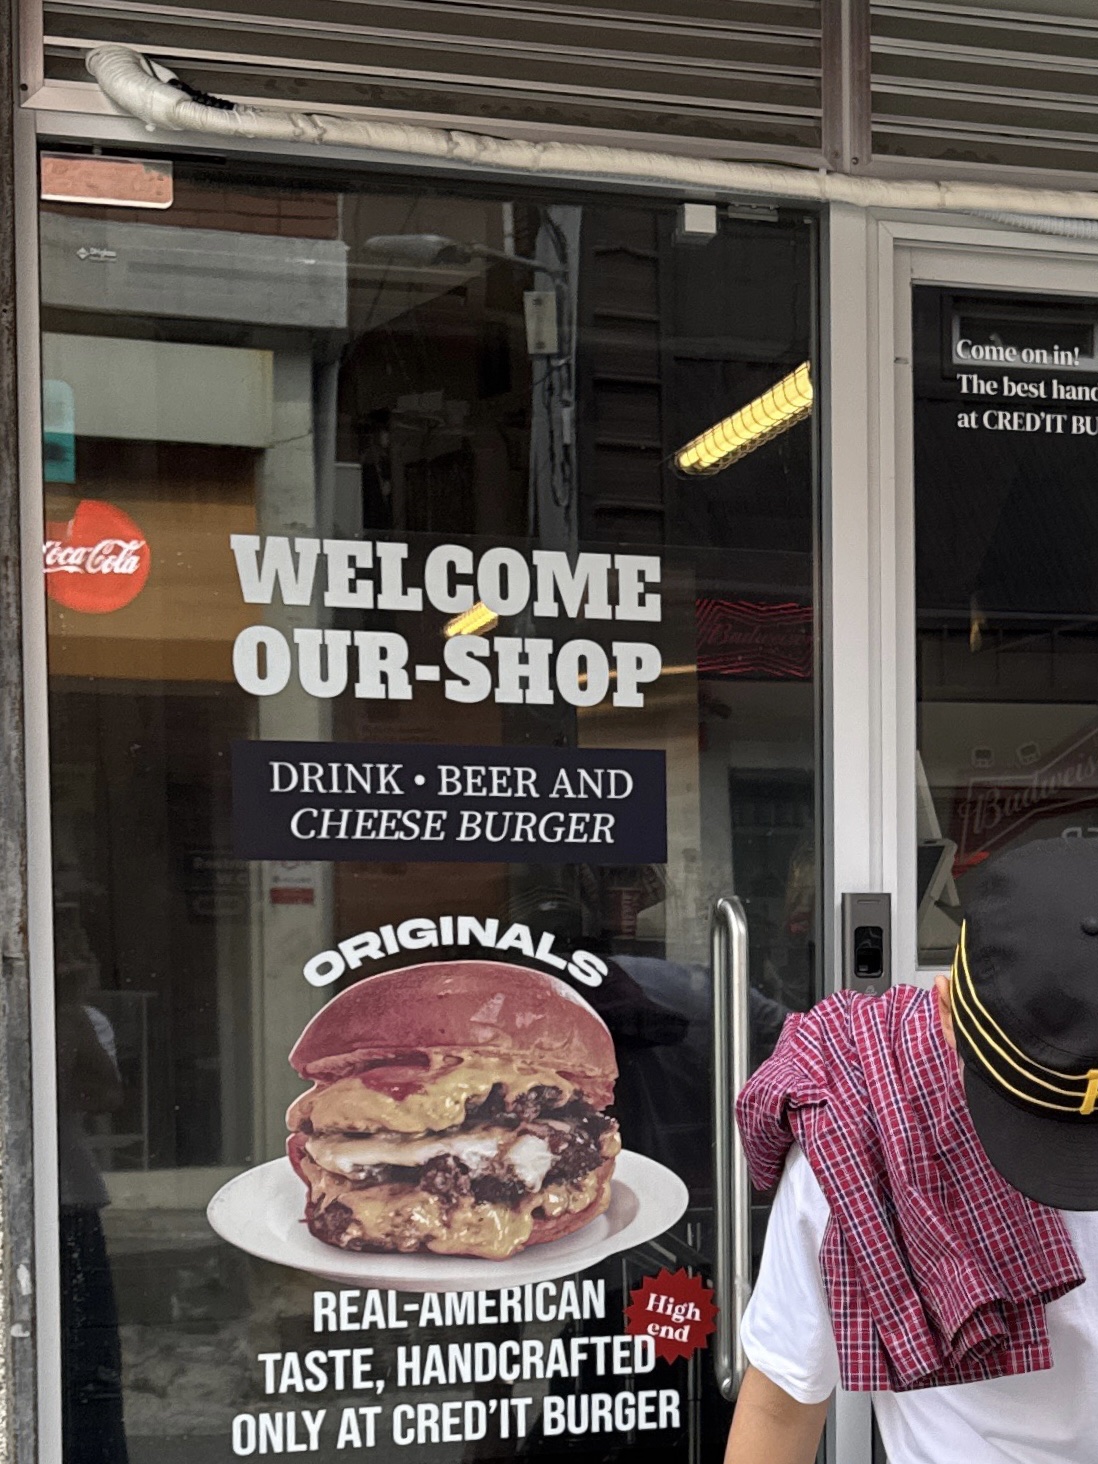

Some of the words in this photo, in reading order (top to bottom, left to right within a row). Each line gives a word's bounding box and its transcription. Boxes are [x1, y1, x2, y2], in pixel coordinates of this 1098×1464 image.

[957, 340, 1016, 364] Come
[1021, 349, 1048, 364] on
[1052, 345, 1080, 366] in!
[957, 374, 997, 395] The
[1003, 377, 1046, 398] best
[958, 412, 977, 428] at
[983, 411, 1067, 433] CRED'IT
[230, 534, 661, 623] WELCOME
[233, 627, 662, 707] OUR-SHOP
[271, 762, 403, 794] DRINK
[438, 766, 539, 797] BEER
[553, 769, 633, 798] AND
[291, 808, 447, 840] CHEESE
[456, 811, 614, 843] BURGER
[303, 916, 608, 988] ORIGINALS
[313, 1279, 606, 1333] REAL-AMERICAN
[647, 1294, 700, 1325] High
[647, 1321, 691, 1345] end
[258, 1351, 384, 1394] TASTE,
[398, 1335, 655, 1386] HANDCRAFTED
[233, 1410, 326, 1455] ONLY
[337, 1406, 378, 1448] AT
[393, 1402, 527, 1445] CRED'IT
[543, 1390, 680, 1435] BURGER
